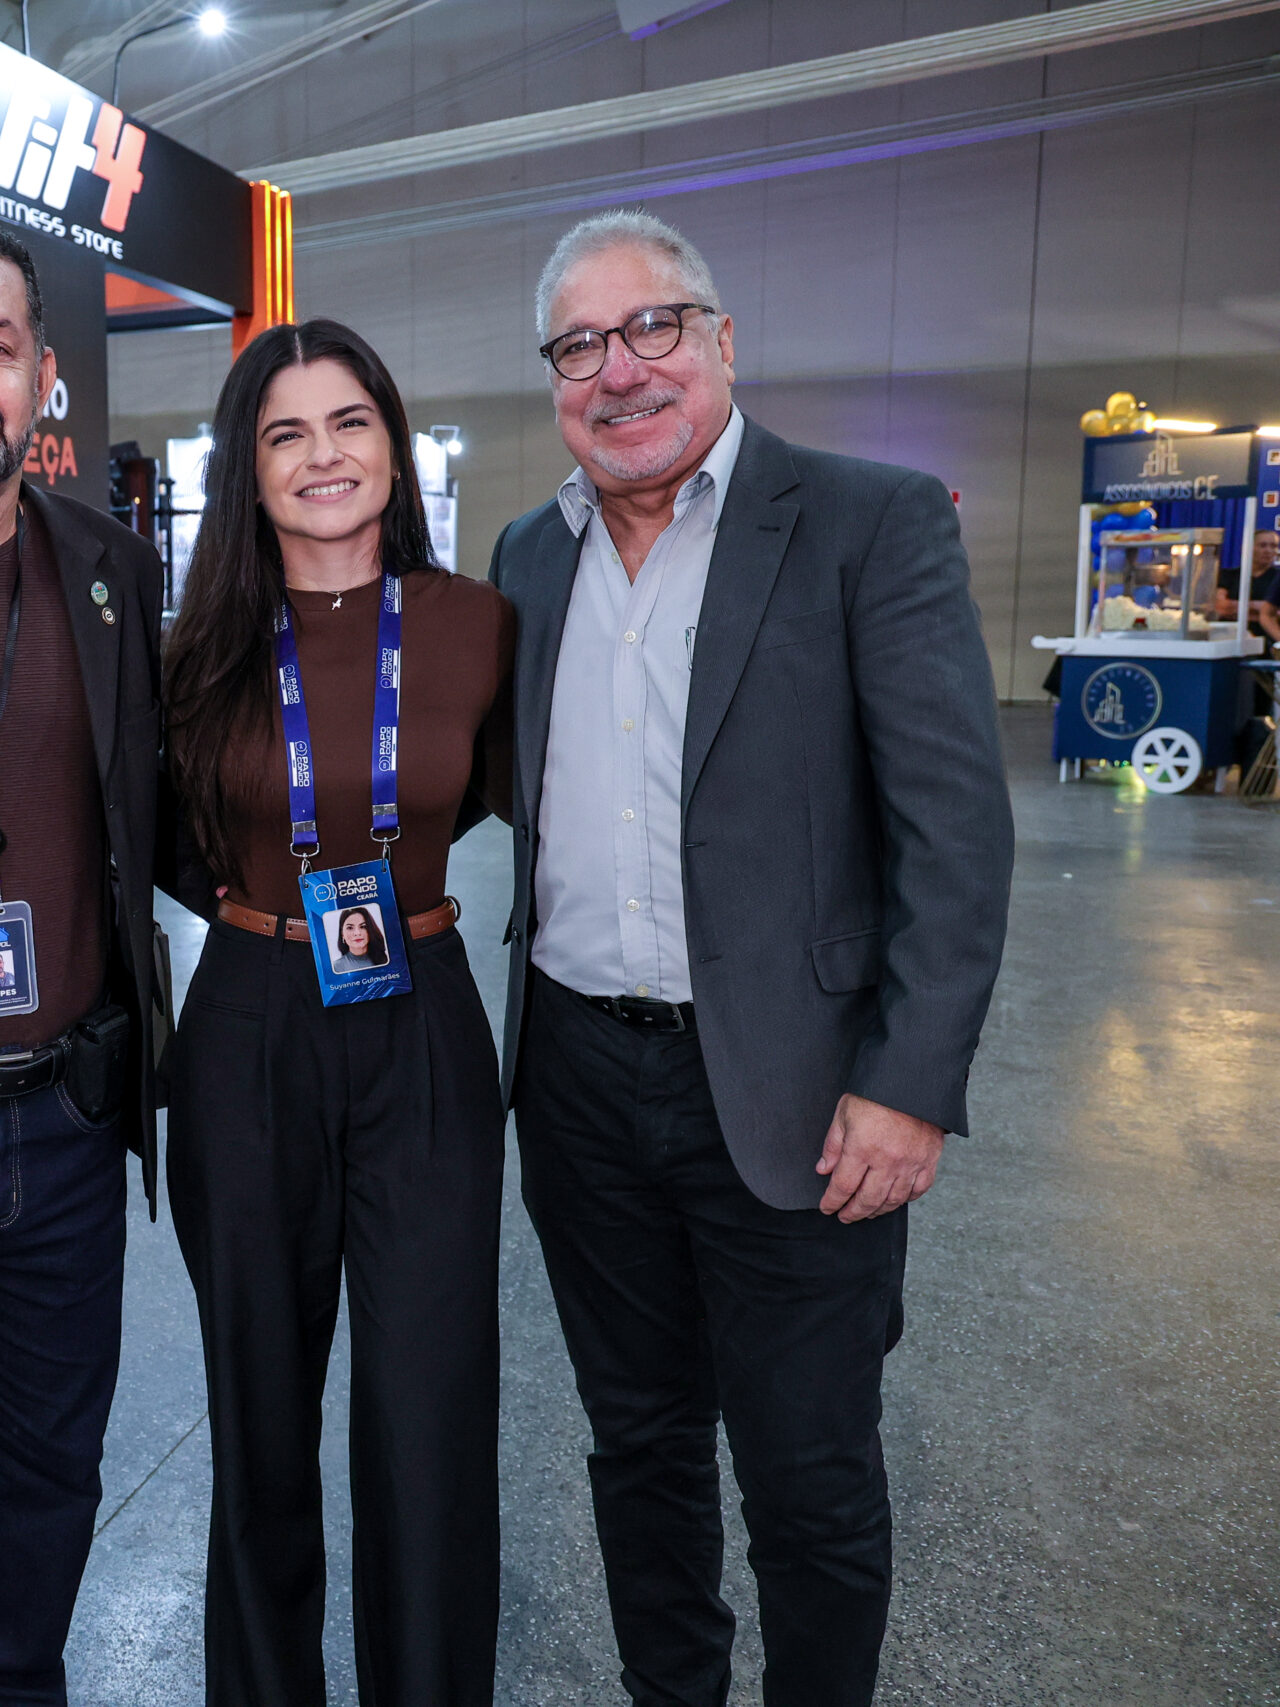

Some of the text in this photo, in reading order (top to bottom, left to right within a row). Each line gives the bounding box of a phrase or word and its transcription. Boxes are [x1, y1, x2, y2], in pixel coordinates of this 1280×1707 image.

[1194, 474, 1219, 501] CE
[286, 679, 294, 704] CONDO
[290, 677, 300, 704] PAPO
[379, 726, 387, 755] PAPO
[302, 756, 310, 787] PAPO
[338, 875, 376, 890] PAPO
[339, 883, 378, 897] CONDO
[356, 892, 378, 901] CEARÁ
[330, 980, 361, 991] Suyanne
